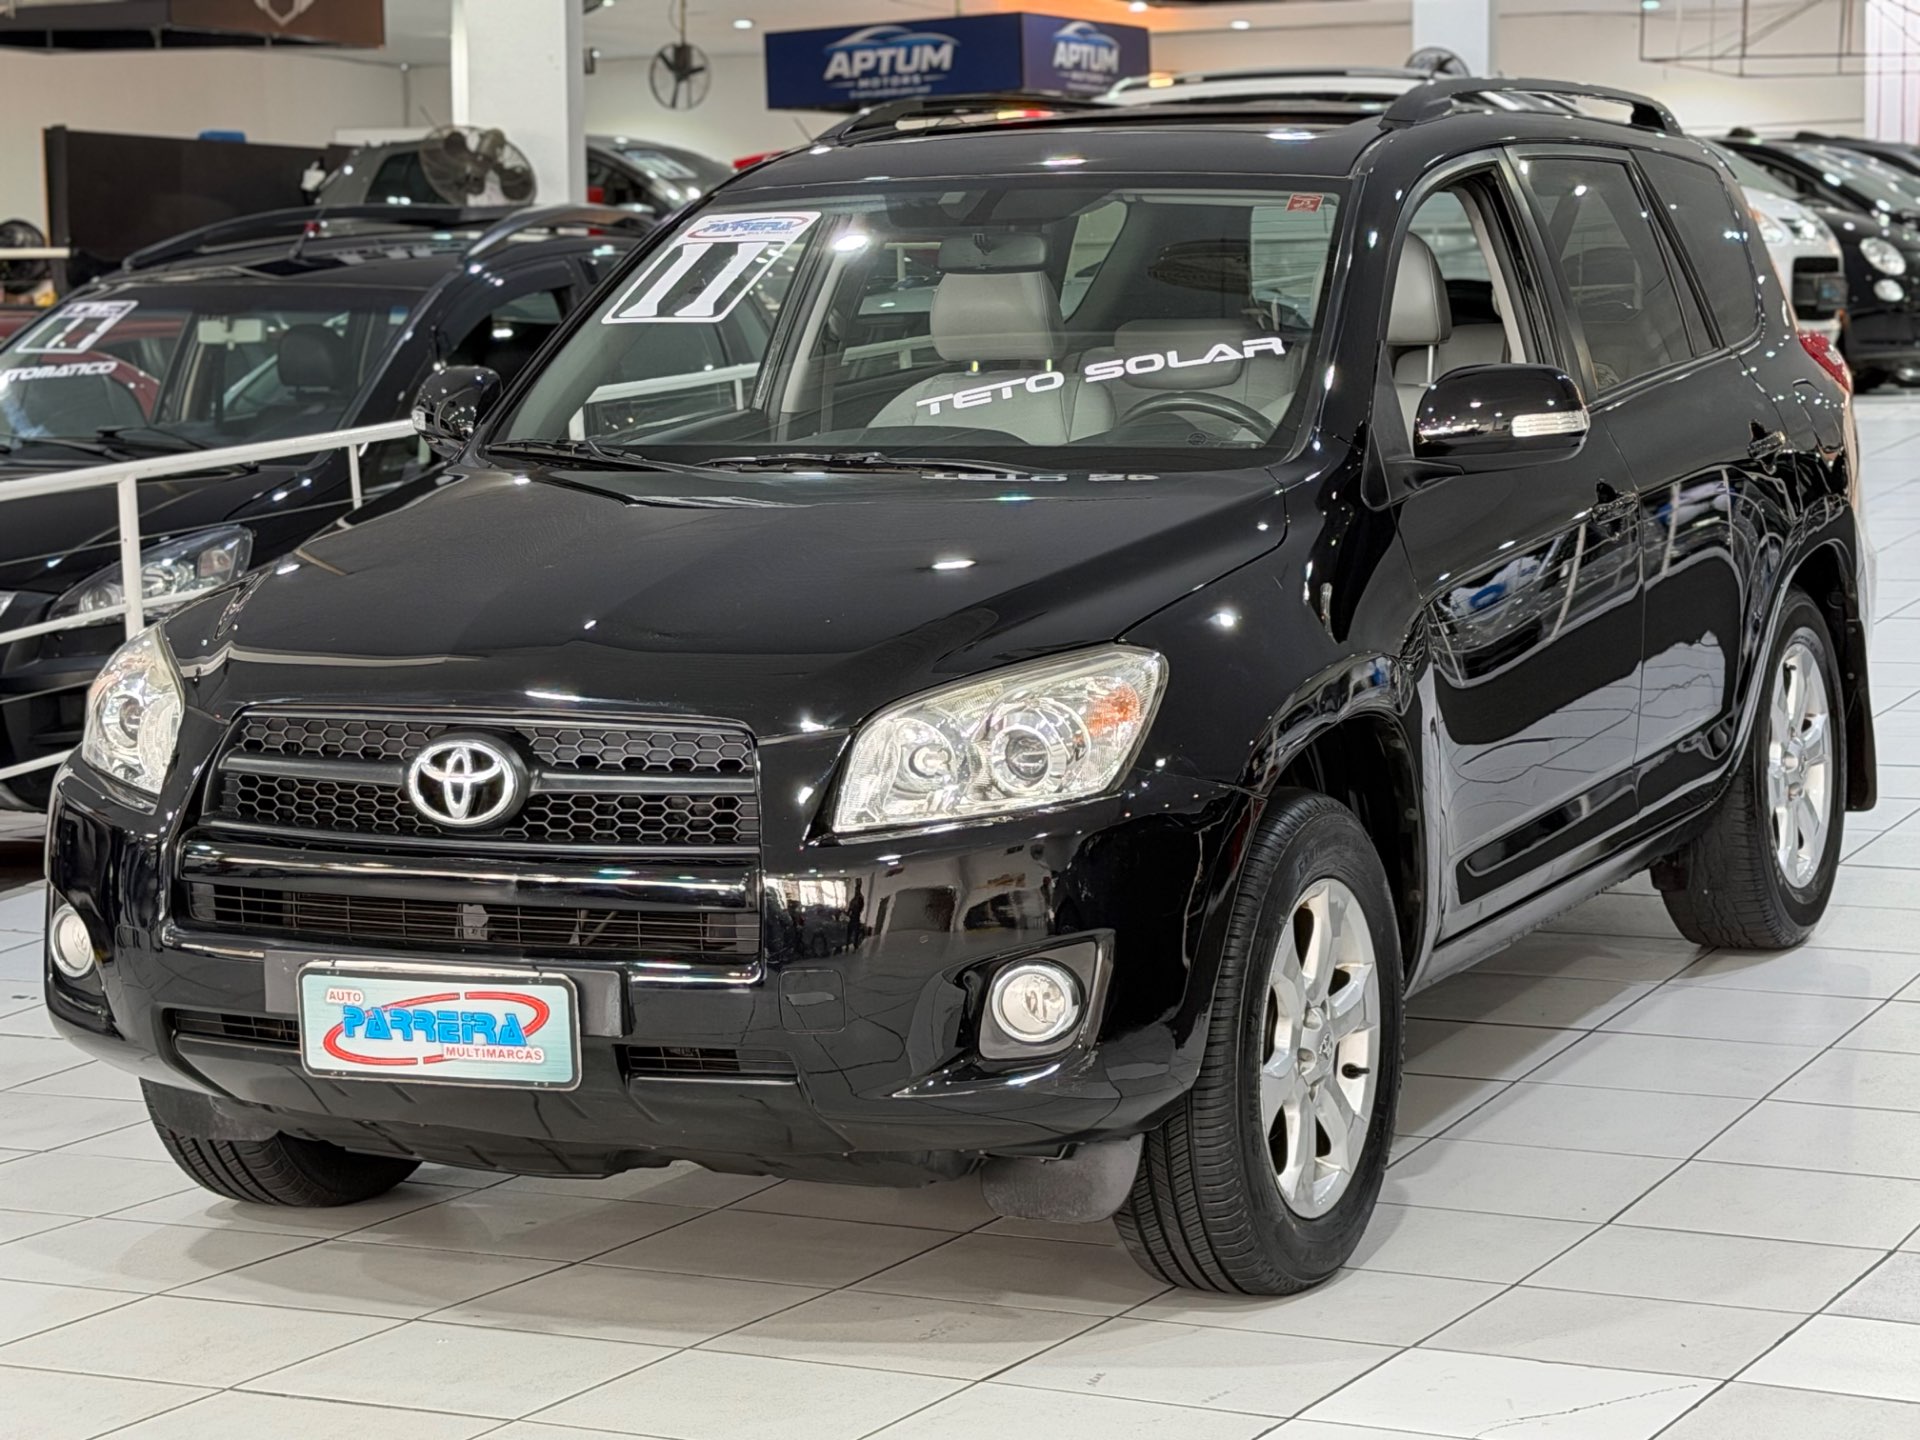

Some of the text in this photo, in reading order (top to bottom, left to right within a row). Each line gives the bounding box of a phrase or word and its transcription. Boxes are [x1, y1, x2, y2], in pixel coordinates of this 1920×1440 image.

[823, 43, 954, 80] APTUM
[1053, 40, 1119, 74] APTUM
[619, 242, 768, 317] 11
[915, 336, 1286, 416] TETO SOLAR
[328, 990, 362, 1003] AUTO
[342, 1004, 528, 1047] PARREIRA
[445, 1046, 543, 1061] MULTIMARCAS
